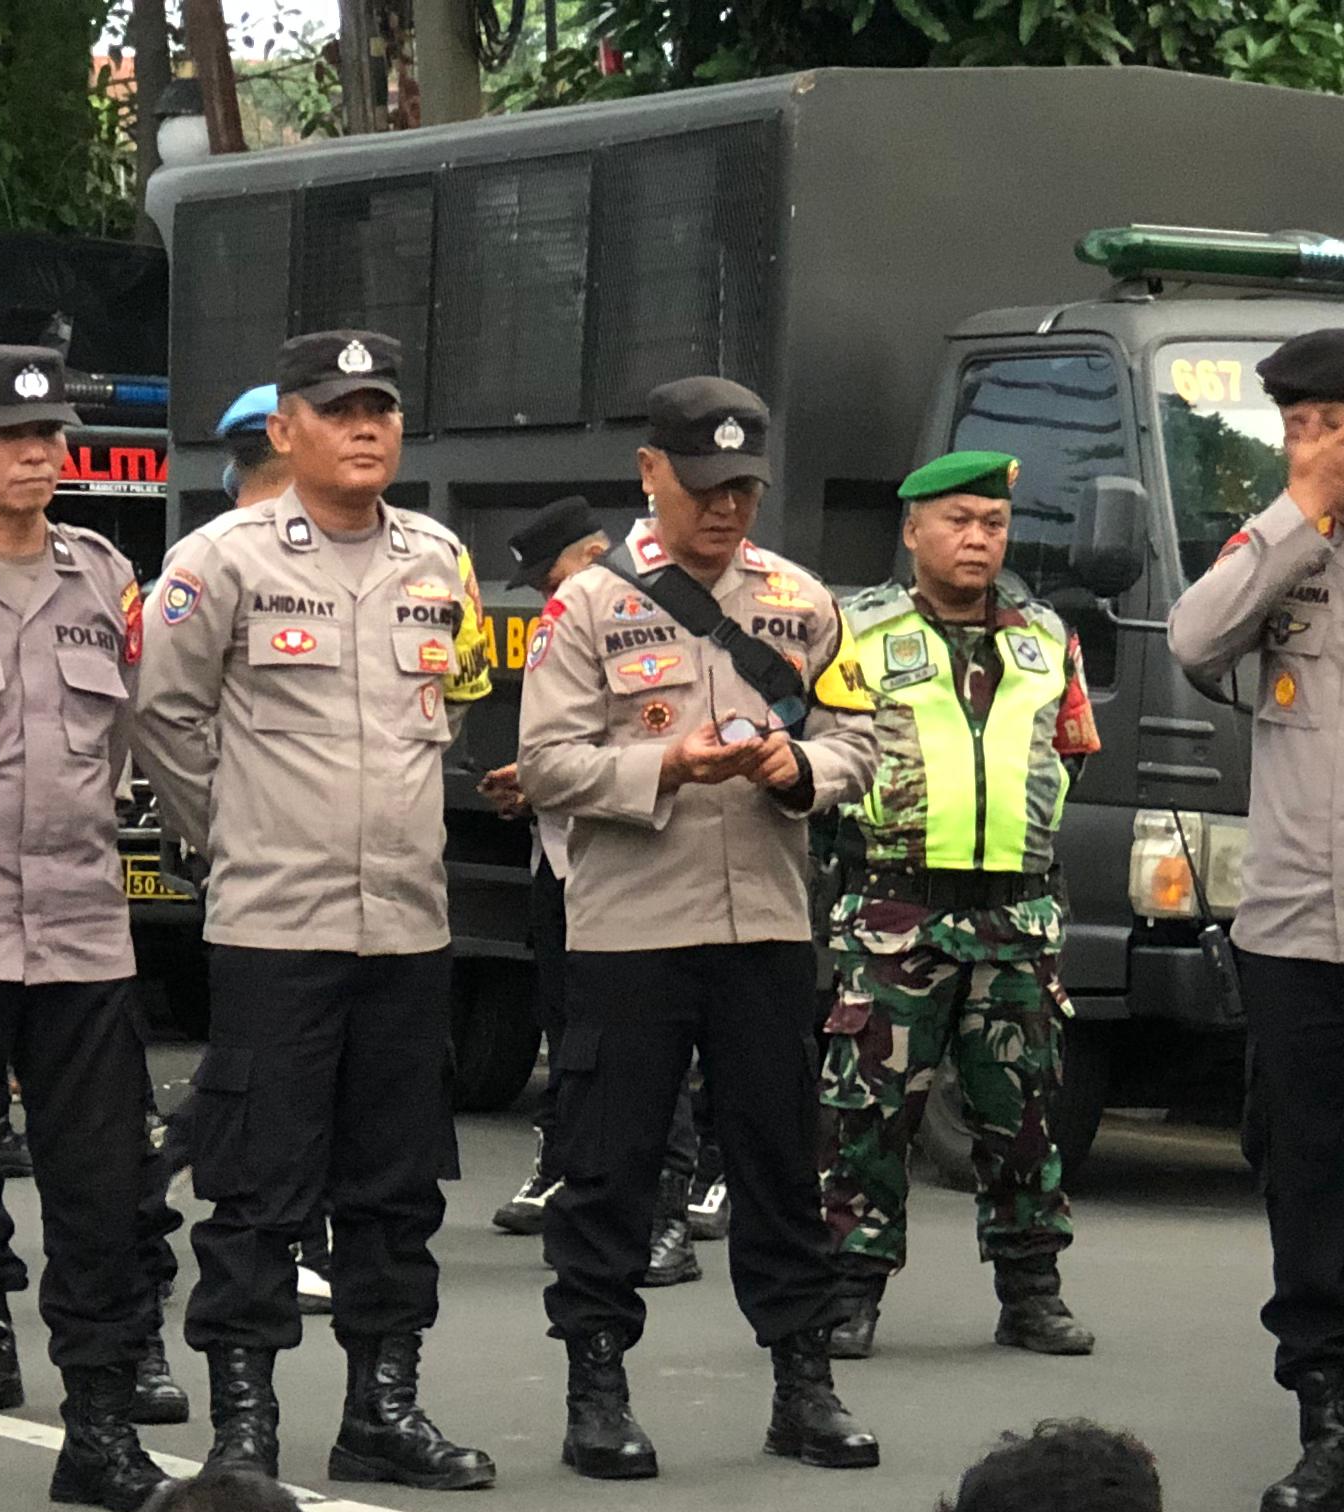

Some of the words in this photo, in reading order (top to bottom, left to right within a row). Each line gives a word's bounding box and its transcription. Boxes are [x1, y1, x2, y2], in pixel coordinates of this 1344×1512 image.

[1171, 359, 1241, 402] 667
[253, 594, 335, 617] A.HIDAYAT
[55, 624, 115, 652] POLRI
